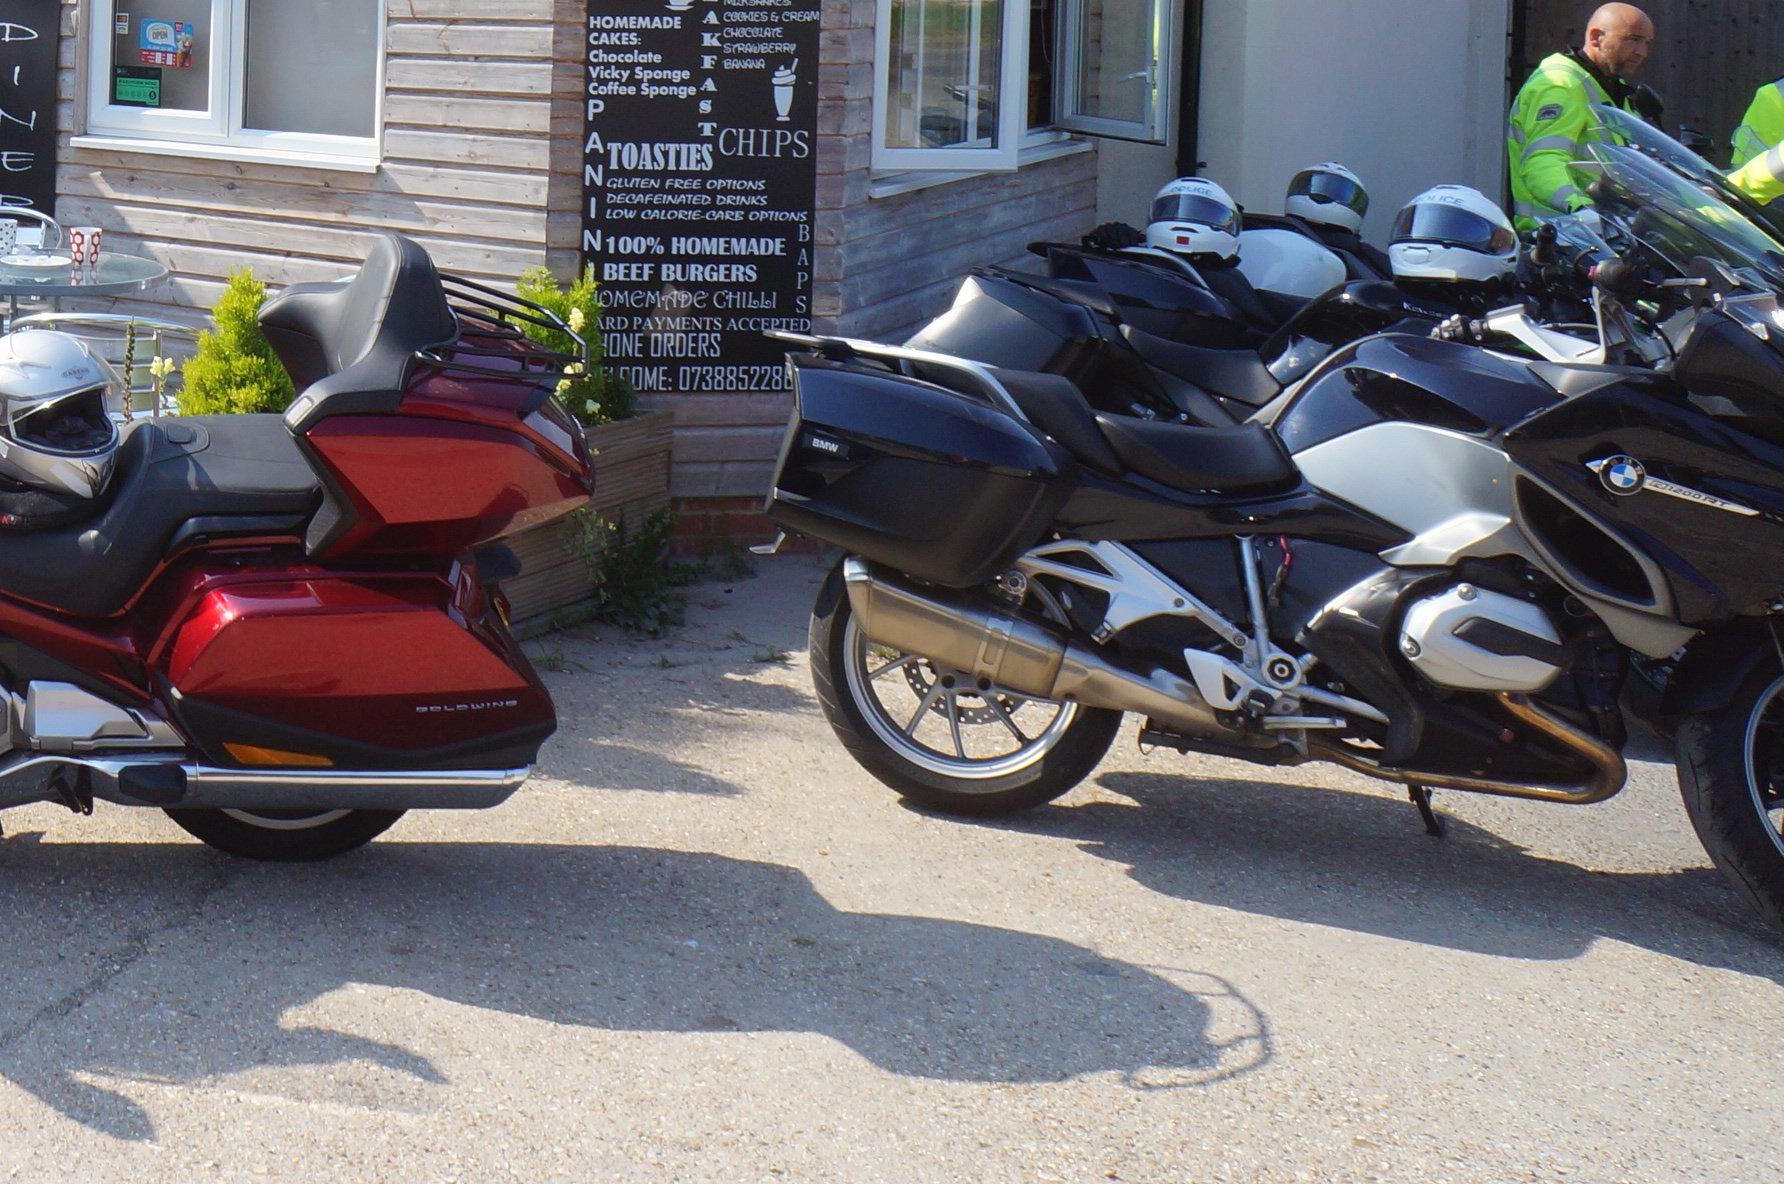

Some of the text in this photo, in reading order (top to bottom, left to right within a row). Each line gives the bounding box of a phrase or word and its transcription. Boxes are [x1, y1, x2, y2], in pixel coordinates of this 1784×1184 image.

[589, 16, 682, 30] HOMEMADE
[723, 11, 820, 23] COOKIES & CREAM
[589, 33, 642, 46] CAKES:
[723, 27, 784, 38] CHOCOLATE
[723, 42, 797, 54] STRAWBERRY
[589, 49, 663, 64] Chocolate
[723, 59, 766, 70] BANANA
[588, 66, 691, 83] Vicky Sponge
[588, 82, 697, 99] Coffee Sponge
[718, 127, 809, 158] CHIPS
[606, 141, 714, 172] TOASTIES
[606, 177, 767, 191] GLUTEN FREE OPTIONS
[606, 193, 768, 206] DECAFEINATED DRINKS
[605, 208, 808, 222] LOW CALORIE-CARB OPTIONS
[606, 236, 787, 256] 100% HOMEMADE
[603, 263, 758, 283] BEEF BURGERS
[796, 224, 810, 314] BAPS
[713, 290, 777, 309] CHILLI
[597, 316, 811, 333] ARD PAYMENTS ACCEPTED
[601, 333, 721, 358] HONE ORDERS
[812, 437, 839, 453] BMW
